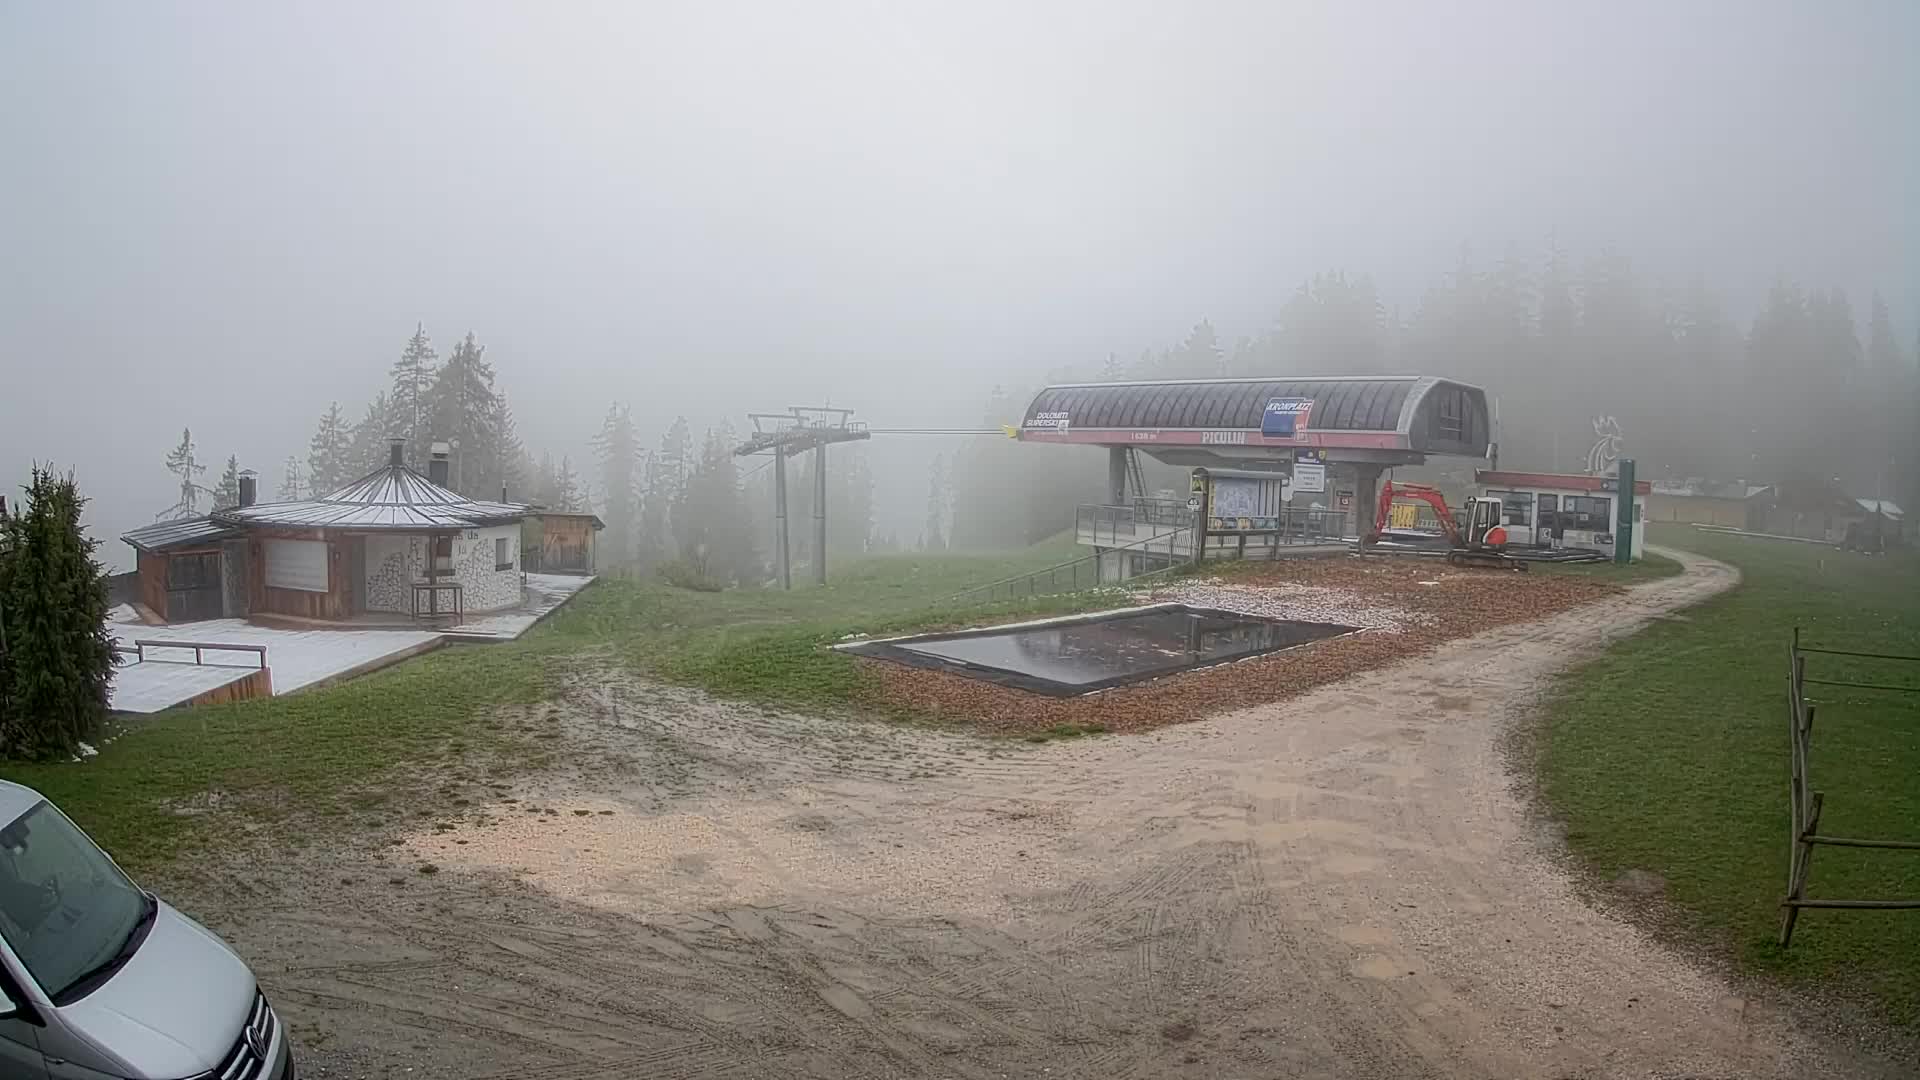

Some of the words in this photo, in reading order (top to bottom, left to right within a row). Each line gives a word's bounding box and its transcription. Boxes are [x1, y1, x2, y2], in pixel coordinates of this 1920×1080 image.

[1266, 402, 1312, 411] KRONPLATZ
[1037, 411, 1069, 419] DOLOMITI
[1202, 431, 1246, 444] PICULIN
